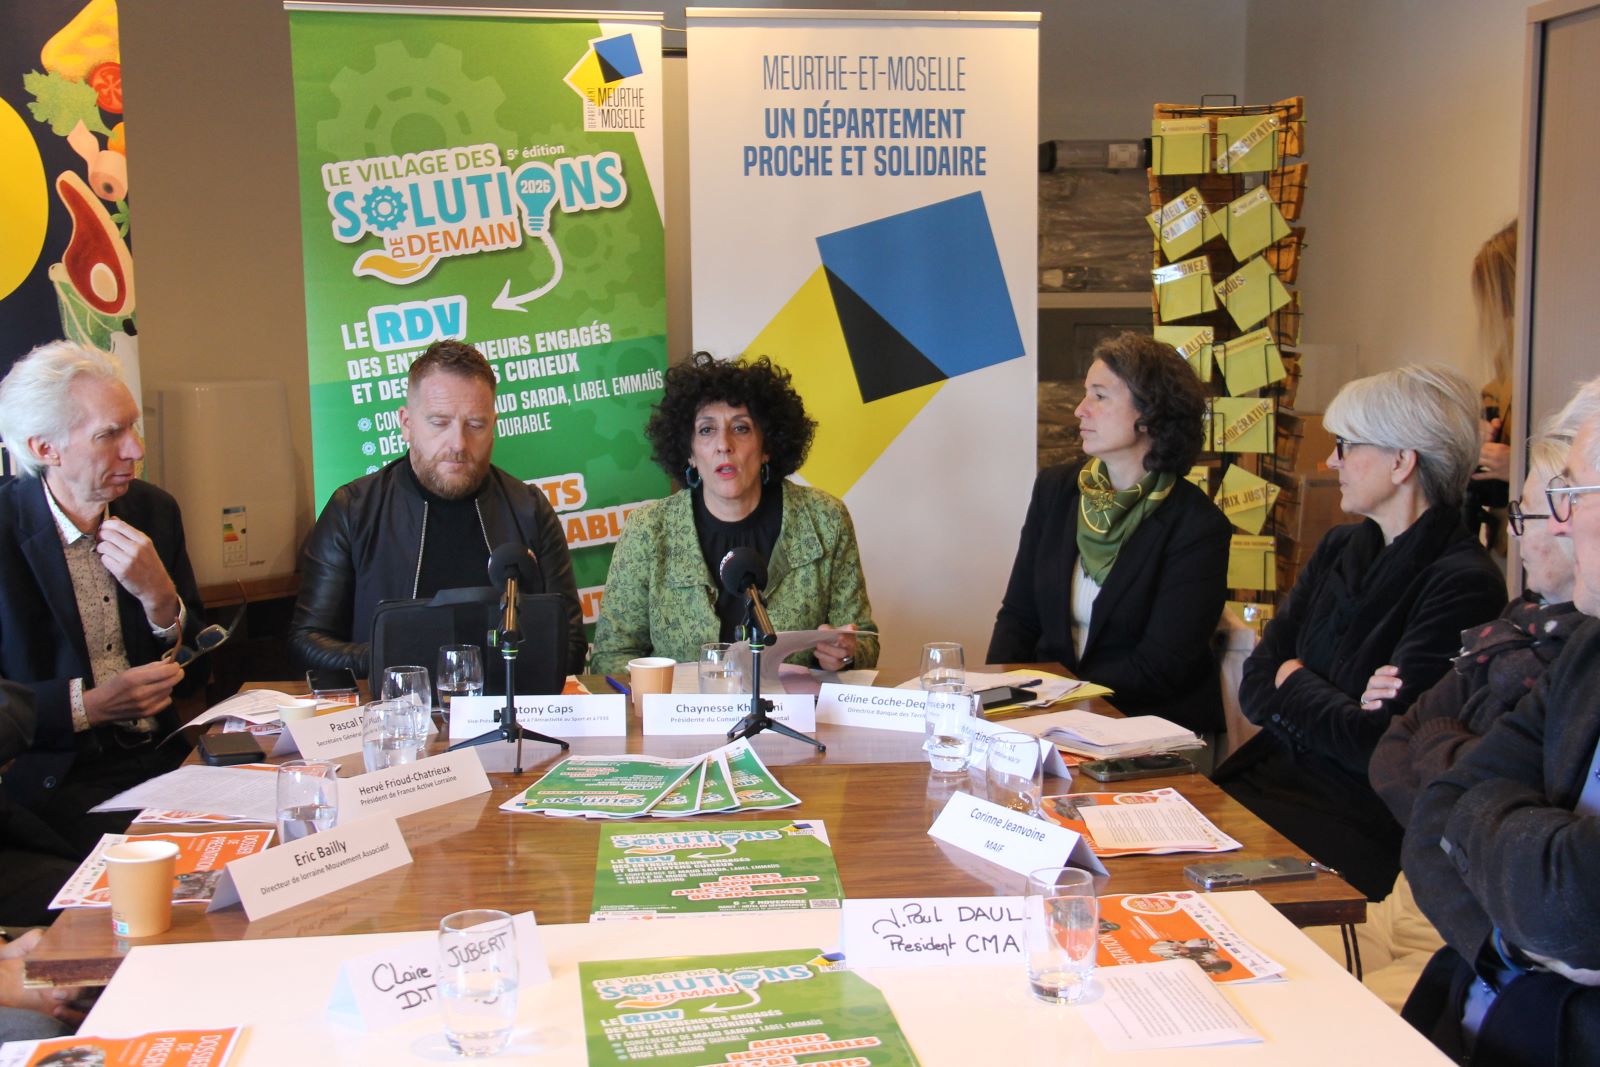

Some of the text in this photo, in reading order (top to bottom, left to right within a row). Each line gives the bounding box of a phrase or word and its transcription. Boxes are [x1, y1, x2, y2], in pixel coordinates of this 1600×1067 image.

[763, 55, 966, 91] MEURTHE-ET-MOSELLE
[598, 87, 645, 108] MEURTHE
[601, 108, 646, 129] MOSELLE
[764, 100, 966, 139] UN DÉPARTEMENT
[521, 143, 566, 158] édition
[743, 145, 987, 176] PROCHE ET SOLIDAIRE
[327, 148, 497, 188] LE VILLAGE DES
[520, 179, 551, 195] 2026
[390, 236, 405, 258] DE
[408, 220, 518, 256] DEMAIN
[341, 302, 461, 350] LE RDV
[347, 357, 382, 381] DES
[534, 320, 612, 353] ENGAGÉS
[504, 352, 580, 383] CURIEUX
[351, 377, 408, 404] ET DES
[521, 385, 572, 408] SARDA,
[573, 380, 610, 402] LABEL
[613, 369, 664, 397] EMMAÜS
[497, 412, 552, 438] DURABLE
[675, 703, 734, 715] Chaynesse
[837, 692, 869, 704] Céline
[515, 704, 574, 716] ntony Caps
[670, 716, 705, 724] Présidente
[329, 716, 359, 733] Pascal
[358, 765, 452, 796] Hervé Frioud-Chatrieux
[360, 793, 389, 806] Président
[389, 791, 397, 799] de
[397, 786, 416, 796] France
[417, 782, 434, 792] Active
[969, 807, 1047, 843] Corinne Jeanvoine
[317, 840, 348, 860] Bailly
[984, 839, 1006, 853] MAIF
[260, 842, 391, 896] Directeur de lorraine Mouvement Associatif
[628, 855, 672, 863] RDV
[958, 906, 1023, 923] DAUL
[965, 934, 1021, 954] CMA
[371, 931, 508, 993] Claire JUBERT
[654, 986, 736, 1001] DEMAIN
[600, 1010, 681, 1027] LE RDV
[604, 1025, 629, 1034] DES
[631, 1015, 729, 1032] ENTREPRENEURS
[607, 1017, 763, 1041] ET DES CITOYENS CURIEUX
[728, 1037, 880, 1061] RESPONSABLES
[751, 1033, 828, 1049] ACHATS
